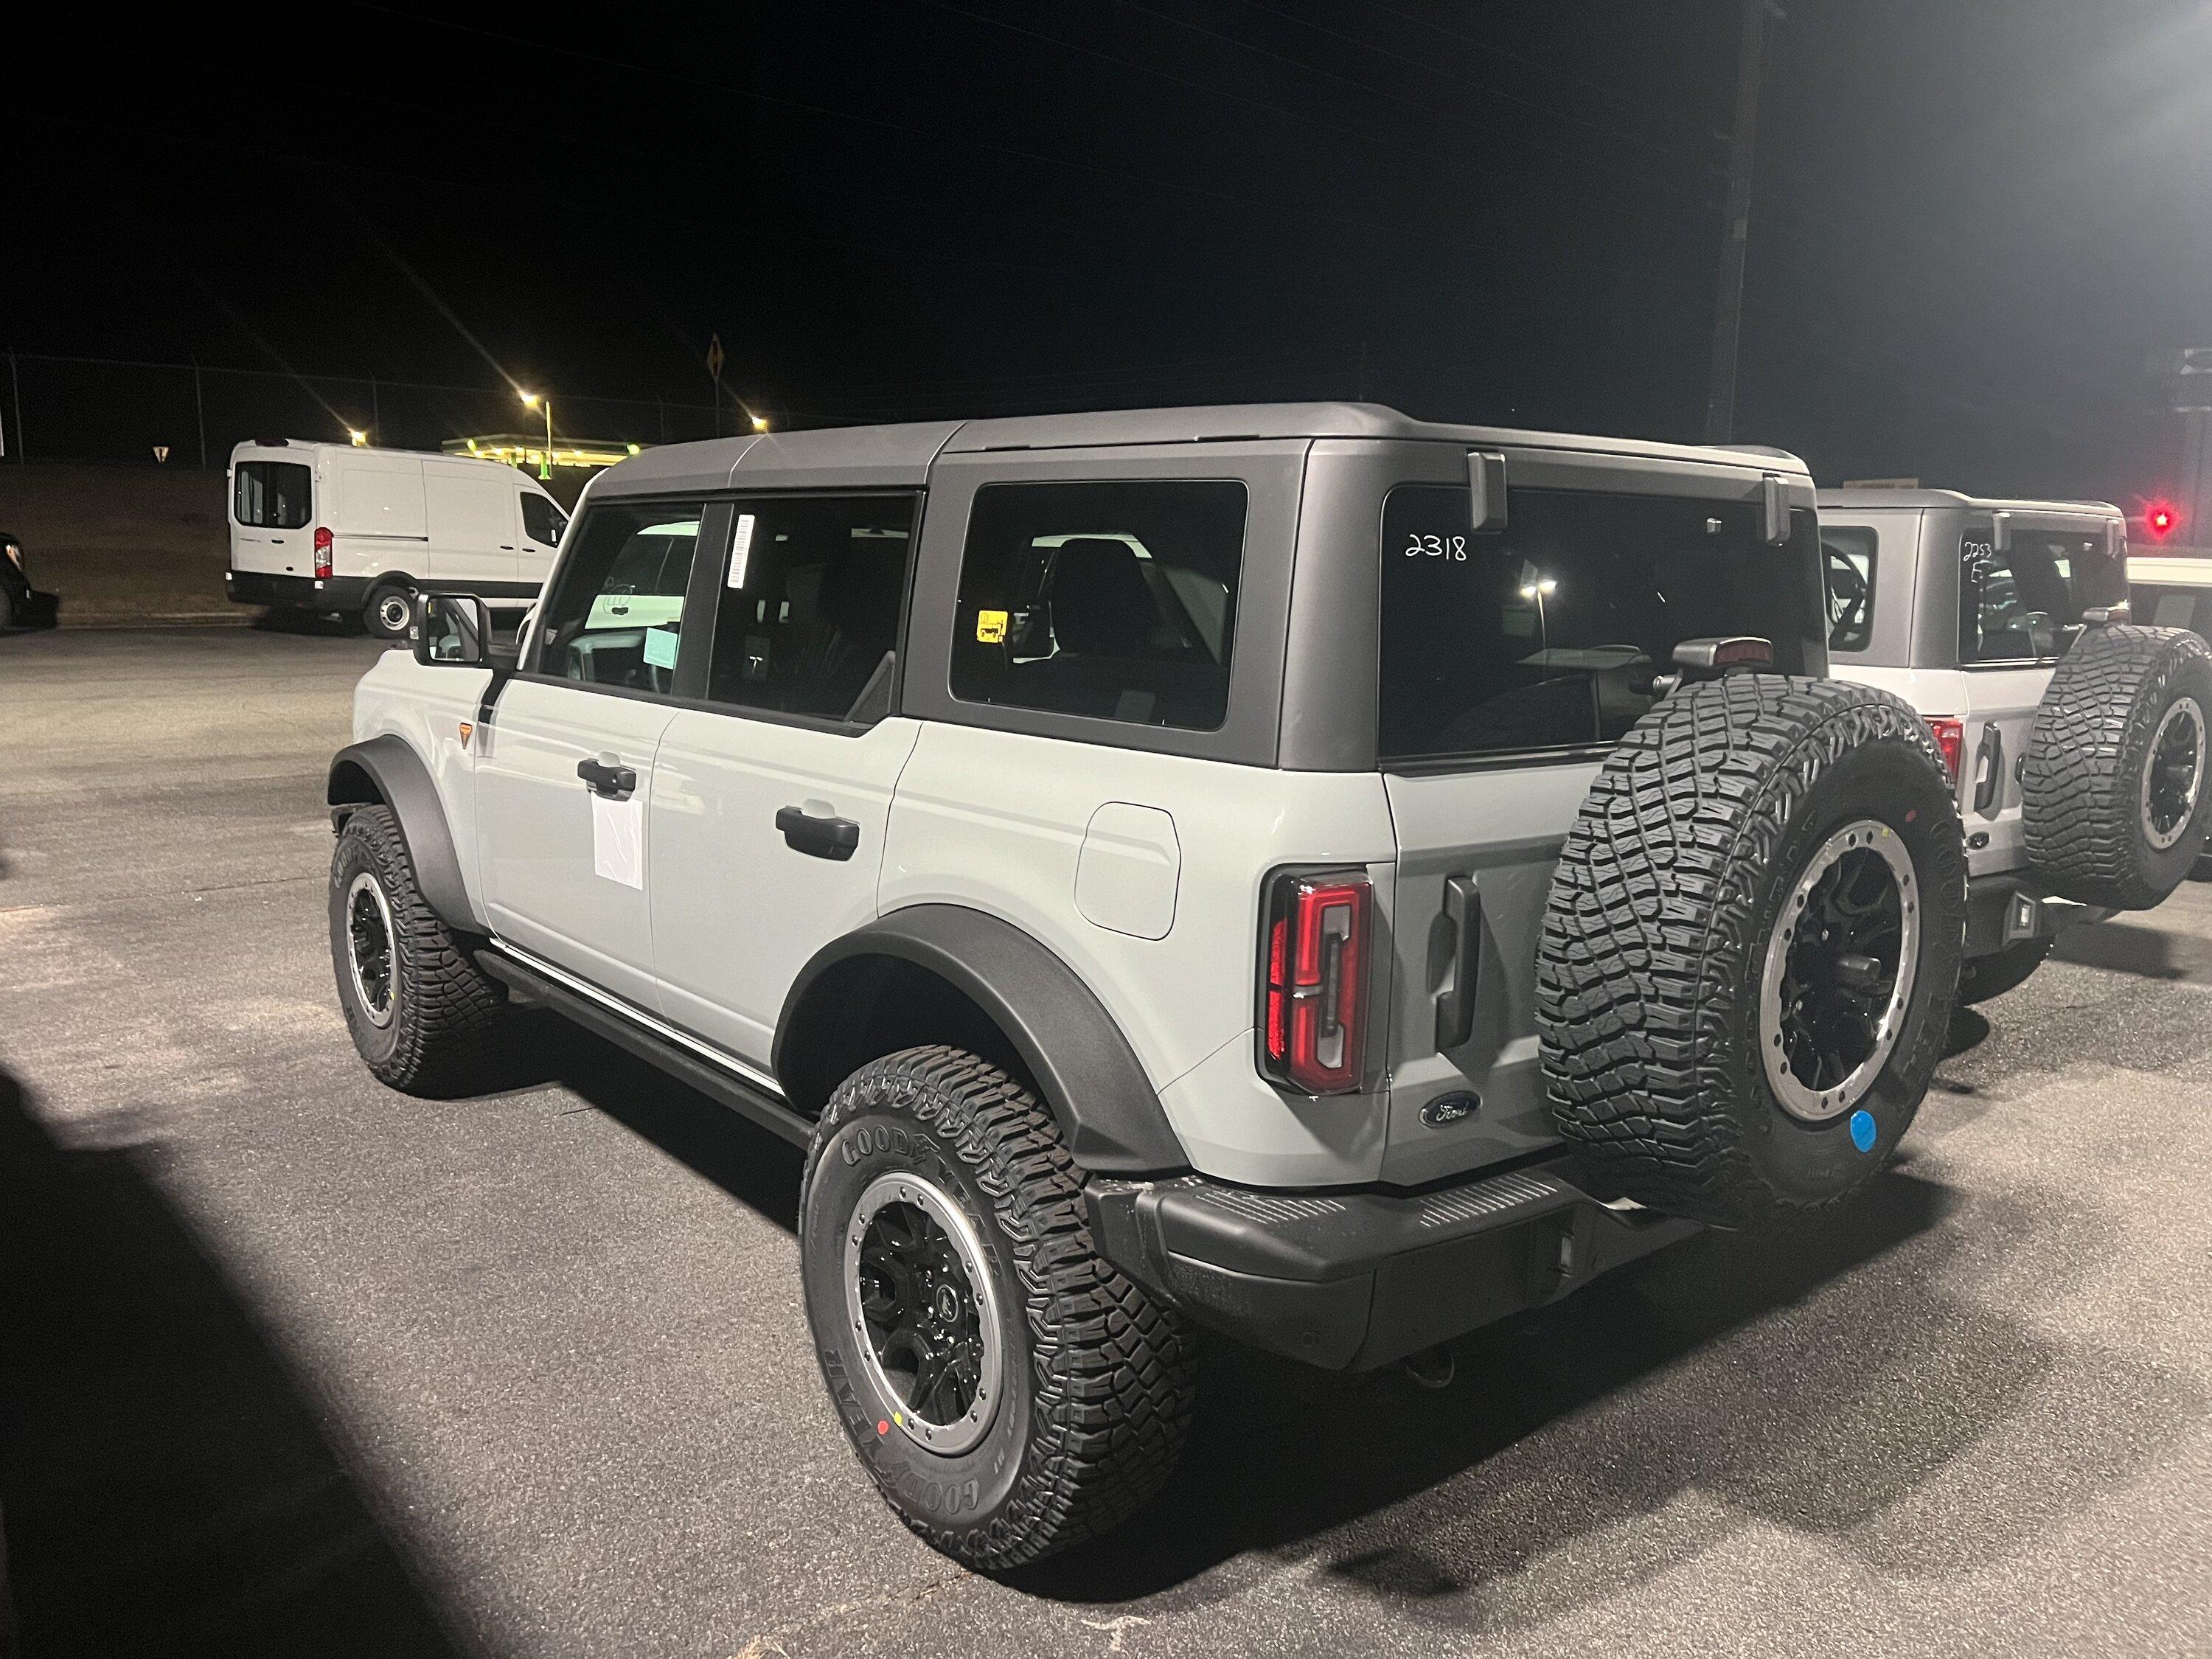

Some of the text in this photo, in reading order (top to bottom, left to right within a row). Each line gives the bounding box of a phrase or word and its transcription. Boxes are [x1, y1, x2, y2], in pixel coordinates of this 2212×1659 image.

[1405, 534, 1467, 561] 2318
[1963, 541, 1992, 562] 2253
[1436, 1101, 1468, 1121] Ford
